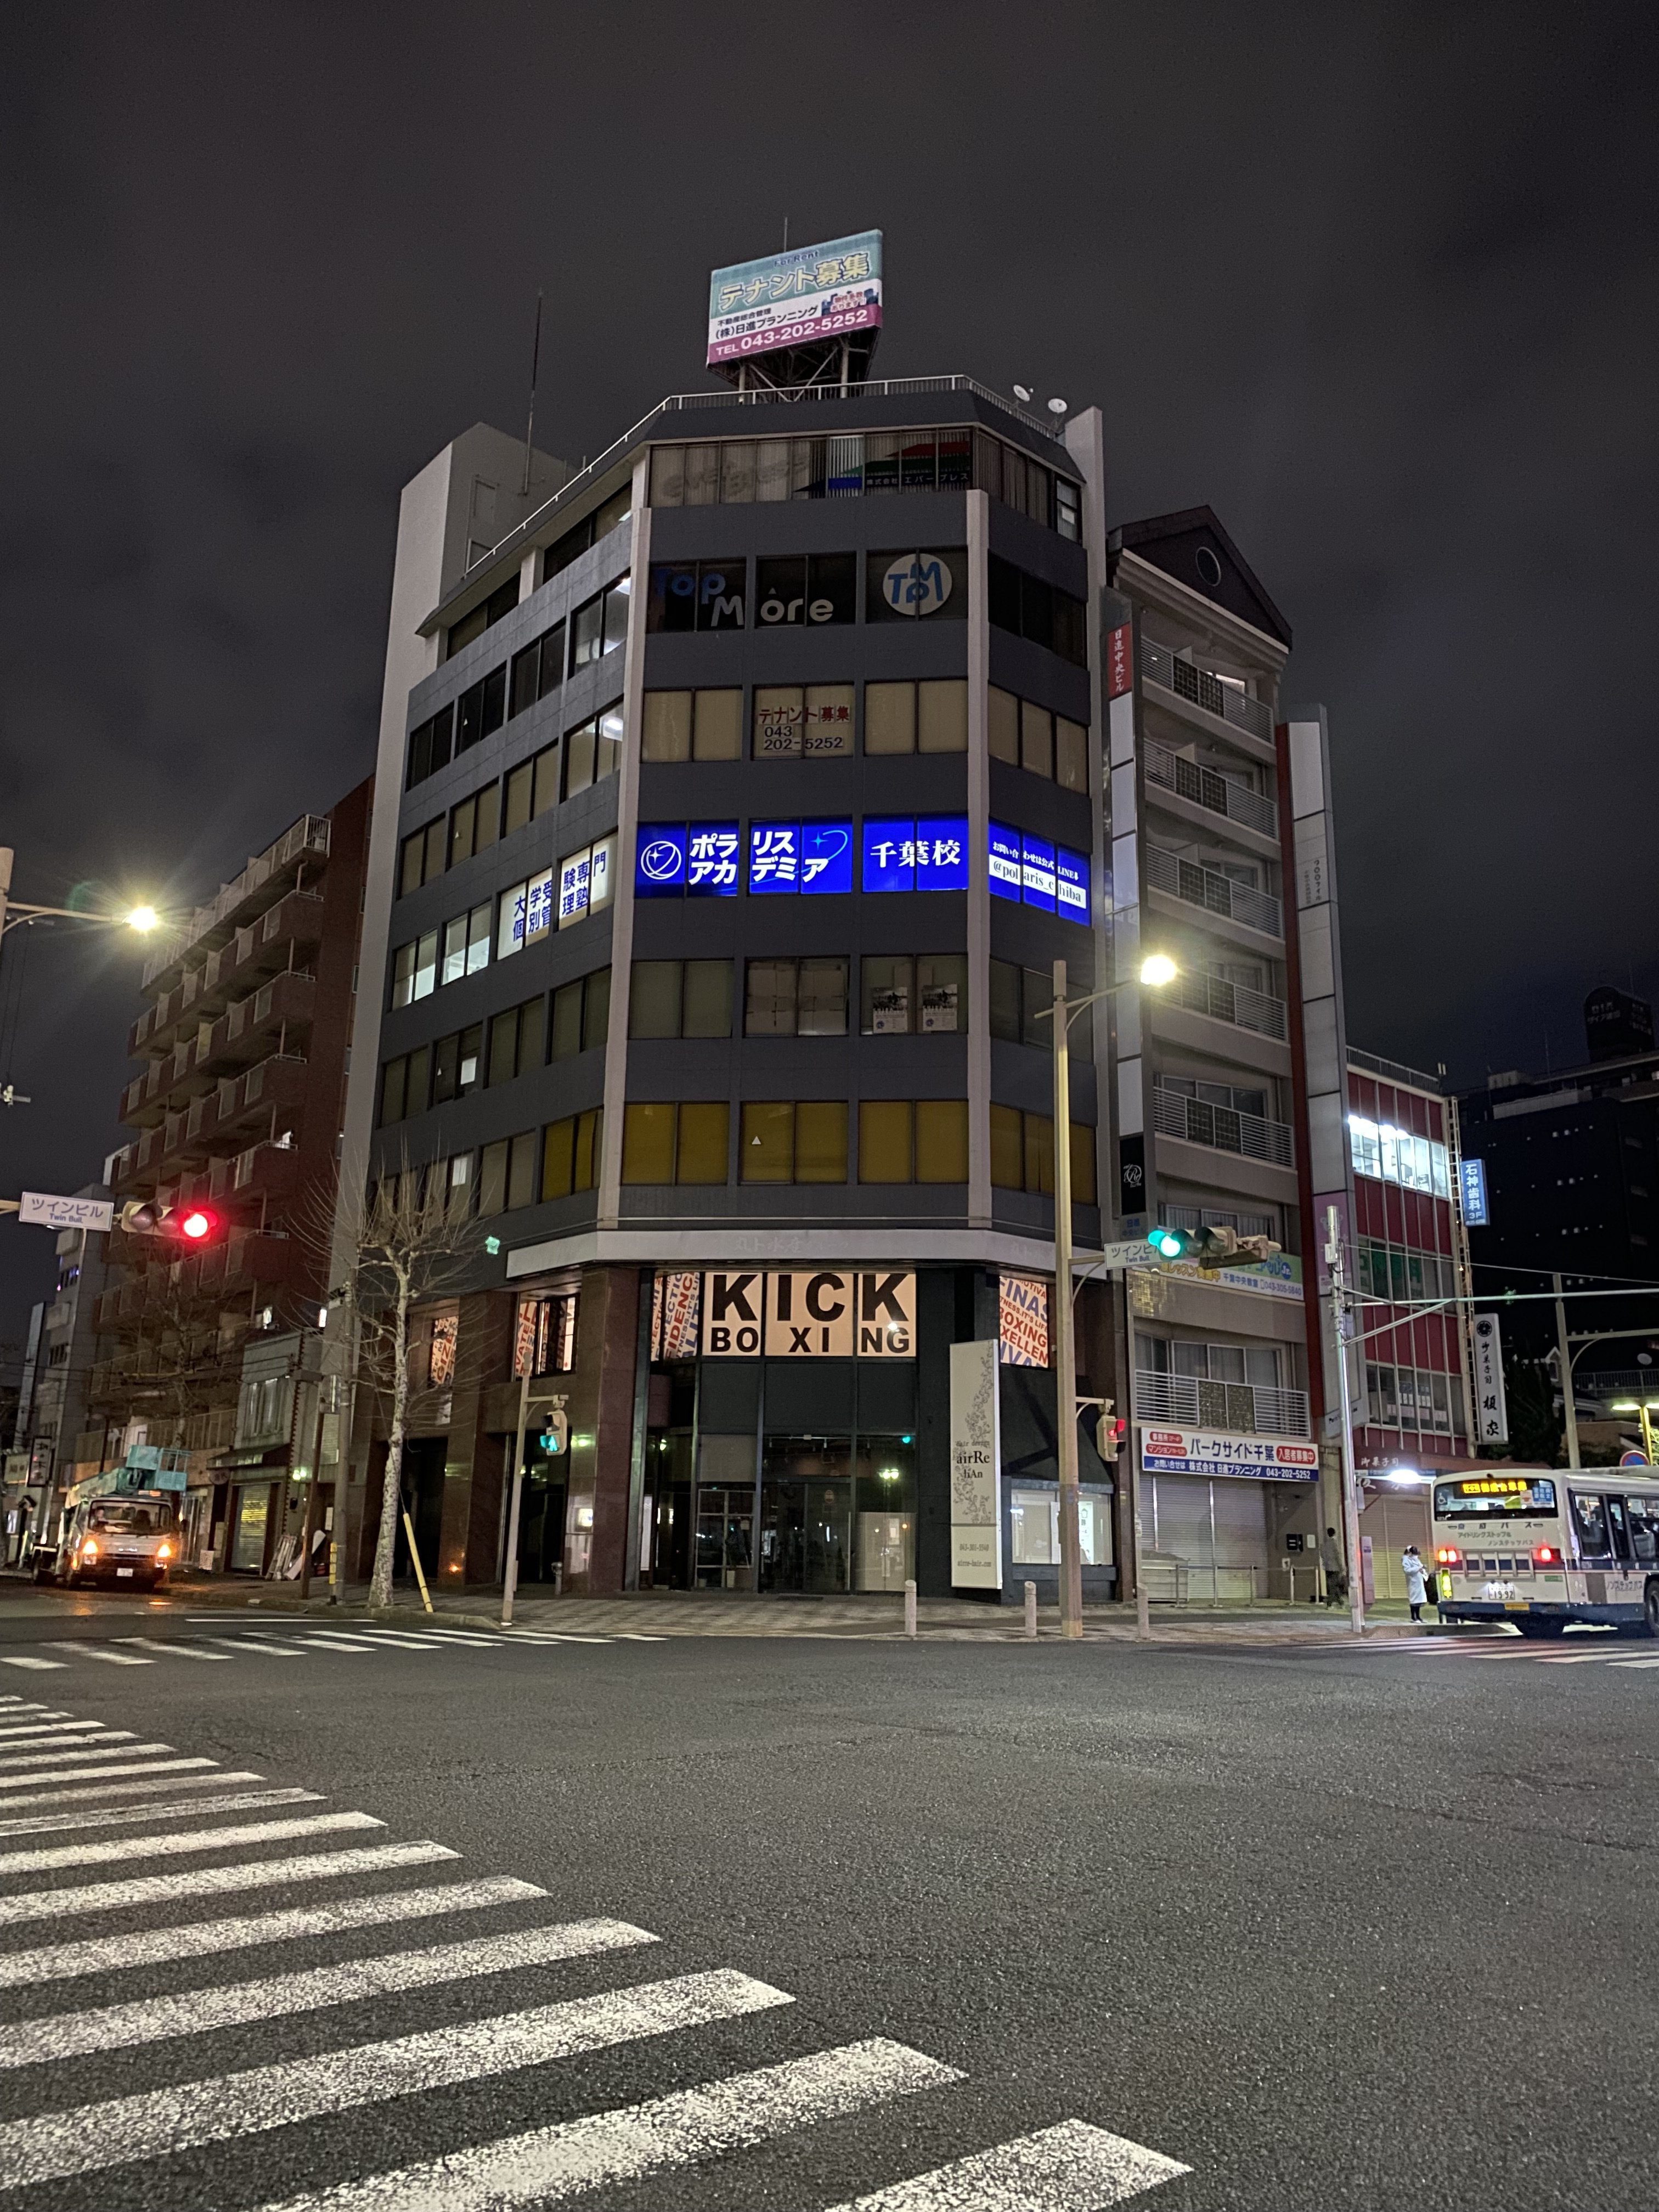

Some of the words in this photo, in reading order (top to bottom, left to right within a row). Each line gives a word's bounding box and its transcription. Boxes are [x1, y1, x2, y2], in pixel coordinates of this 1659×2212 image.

[774, 258, 788, 267] For
[794, 250, 819, 263] Rent
[720, 252, 871, 311] テナント募集
[718, 308, 771, 327] 不動産総合管理
[716, 343, 739, 356] TEL
[741, 309, 868, 349] 043-202-5252
[1114, 629, 1125, 692] 日進中央ビル
[758, 705, 850, 724] テナント募集
[765, 726, 793, 738] 043
[764, 737, 844, 751] 202-5252
[691, 830, 795, 860] ポラリス
[870, 839, 961, 868] 千葉校
[689, 856, 829, 886] アカデミア
[994, 860, 1081, 902] @polaris_chiba
[1465, 1163, 1481, 1211] 石神歯科
[32, 1198, 104, 1218] ツインビル
[49, 1213, 66, 1221] Twin
[1111, 1243, 1157, 1259] ツインビ
[1223, 1273, 1258, 1288] 千葉中央教室
[712, 1273, 909, 1322] KICK
[710, 1327, 910, 1352] BOXING
[956, 1450, 990, 1464] airRe
[1190, 1438, 1274, 1462] パークサイド千葉
[1278, 1447, 1314, 1464] 入居者募集中
[1189, 1462, 1215, 1473] 株式会社
[1217, 1464, 1262, 1476] 日進プランニング
[1266, 1469, 1311, 1480] 043-202-5252
